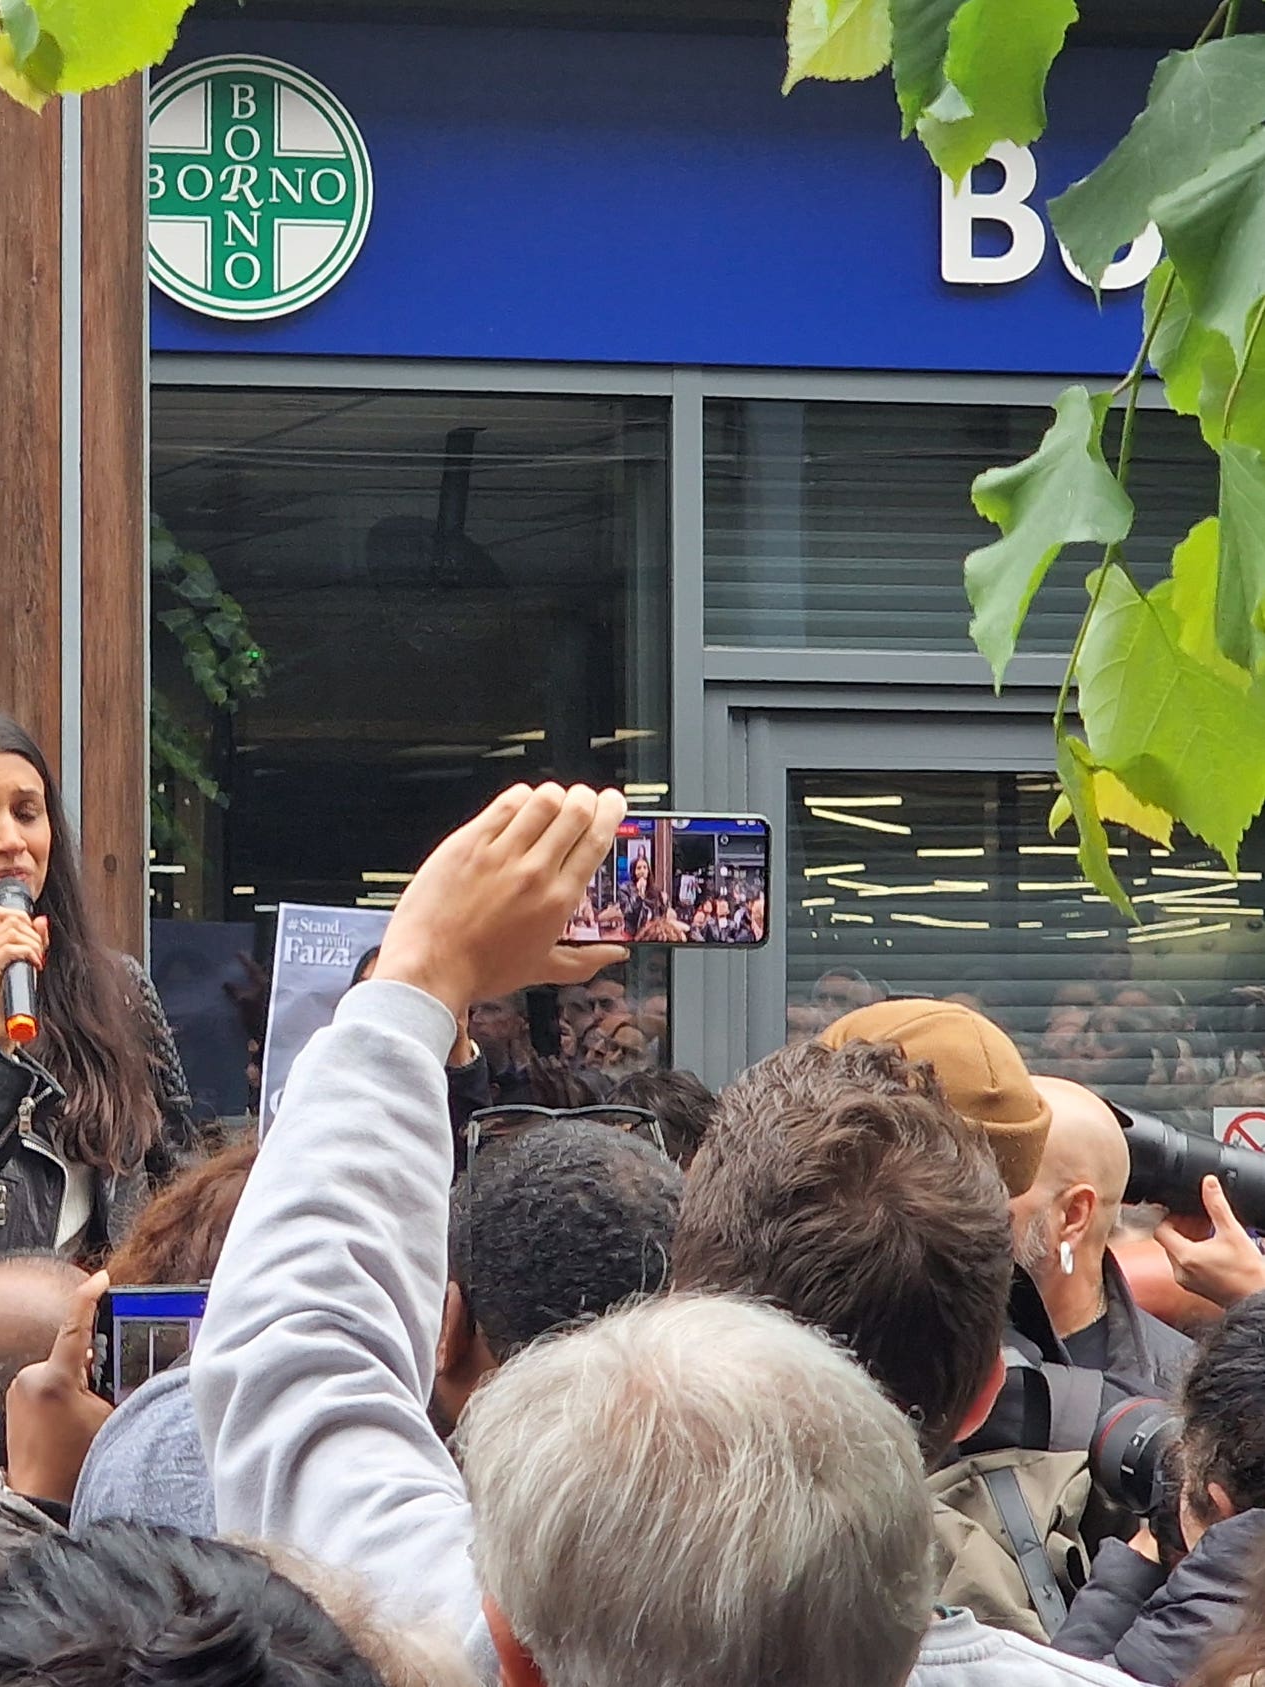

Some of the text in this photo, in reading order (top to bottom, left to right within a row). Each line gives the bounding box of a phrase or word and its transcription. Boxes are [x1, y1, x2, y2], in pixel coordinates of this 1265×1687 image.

[219, 83, 265, 290] BORNO
[286, 917, 340, 934] #Stand
[283, 936, 351, 965] Faiza
